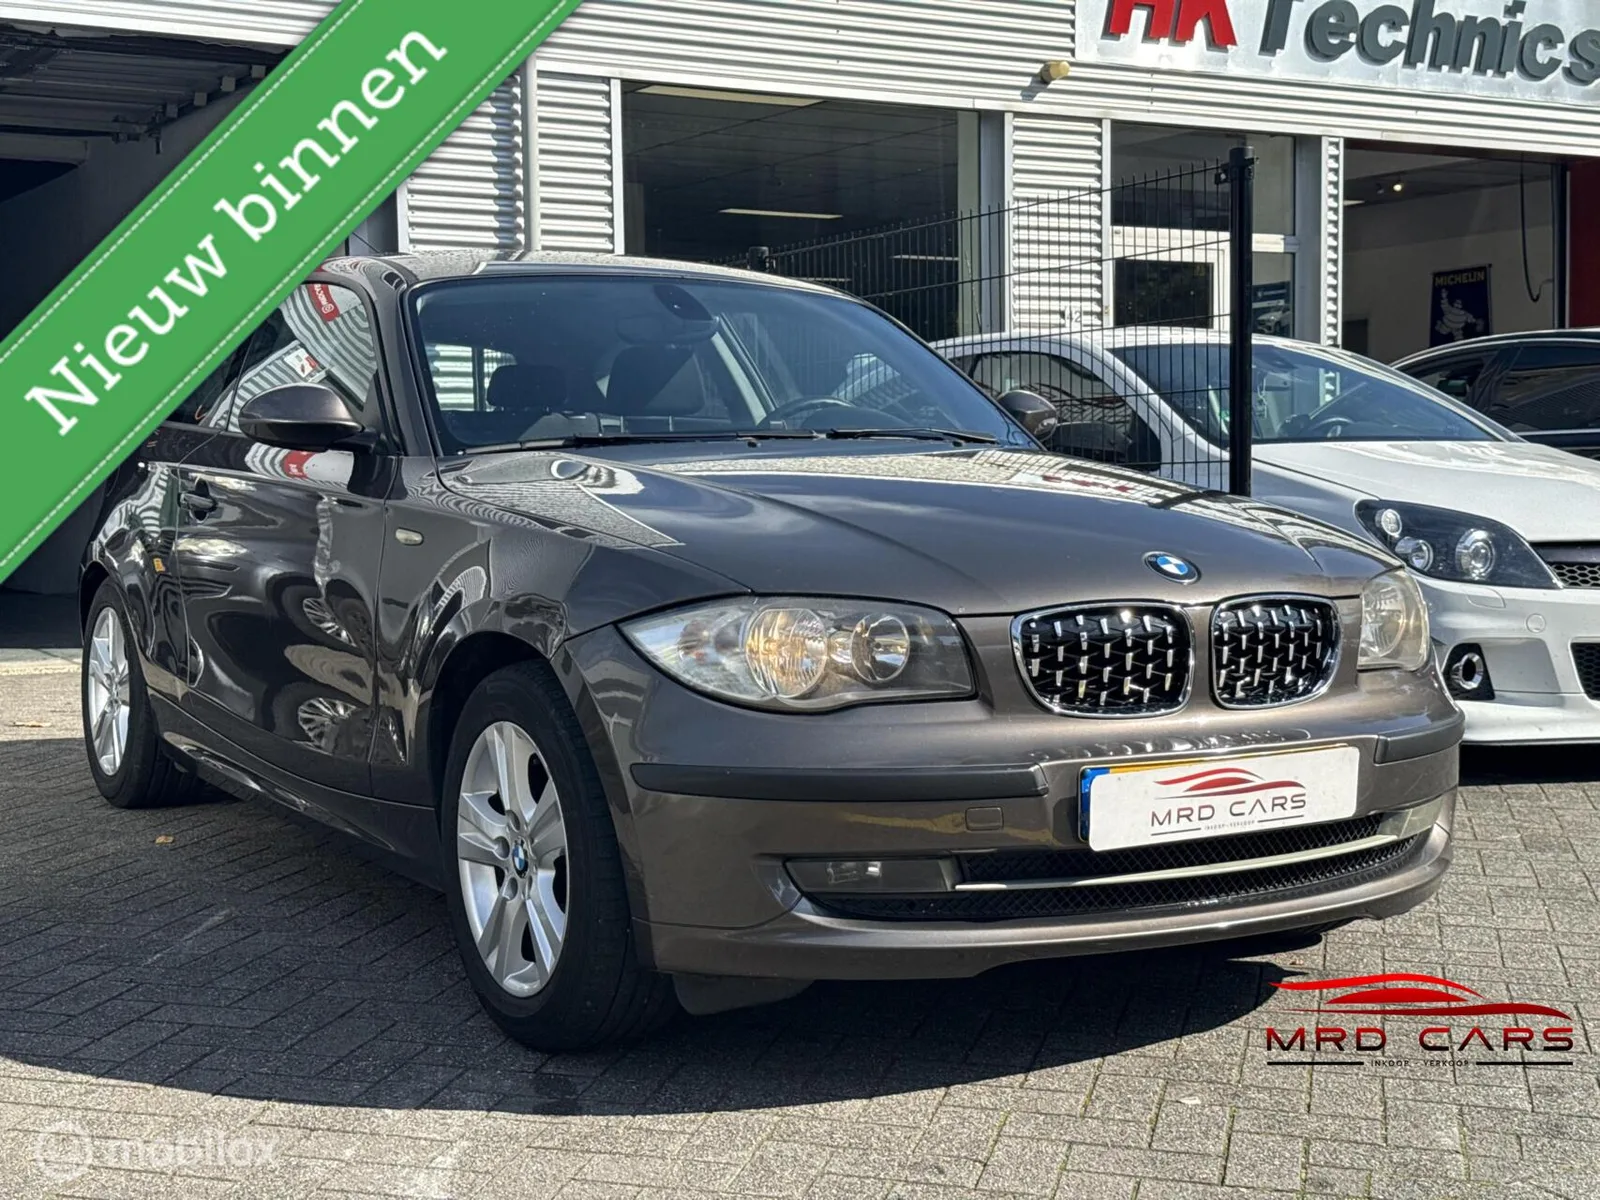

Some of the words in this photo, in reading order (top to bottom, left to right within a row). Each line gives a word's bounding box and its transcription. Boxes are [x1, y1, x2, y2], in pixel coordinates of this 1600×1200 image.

[1259, 0, 1600, 86] Technics
[1435, 270, 1485, 287] MICHELIN
[1150, 804, 1215, 827] MRD
[1229, 793, 1307, 817] CARS
